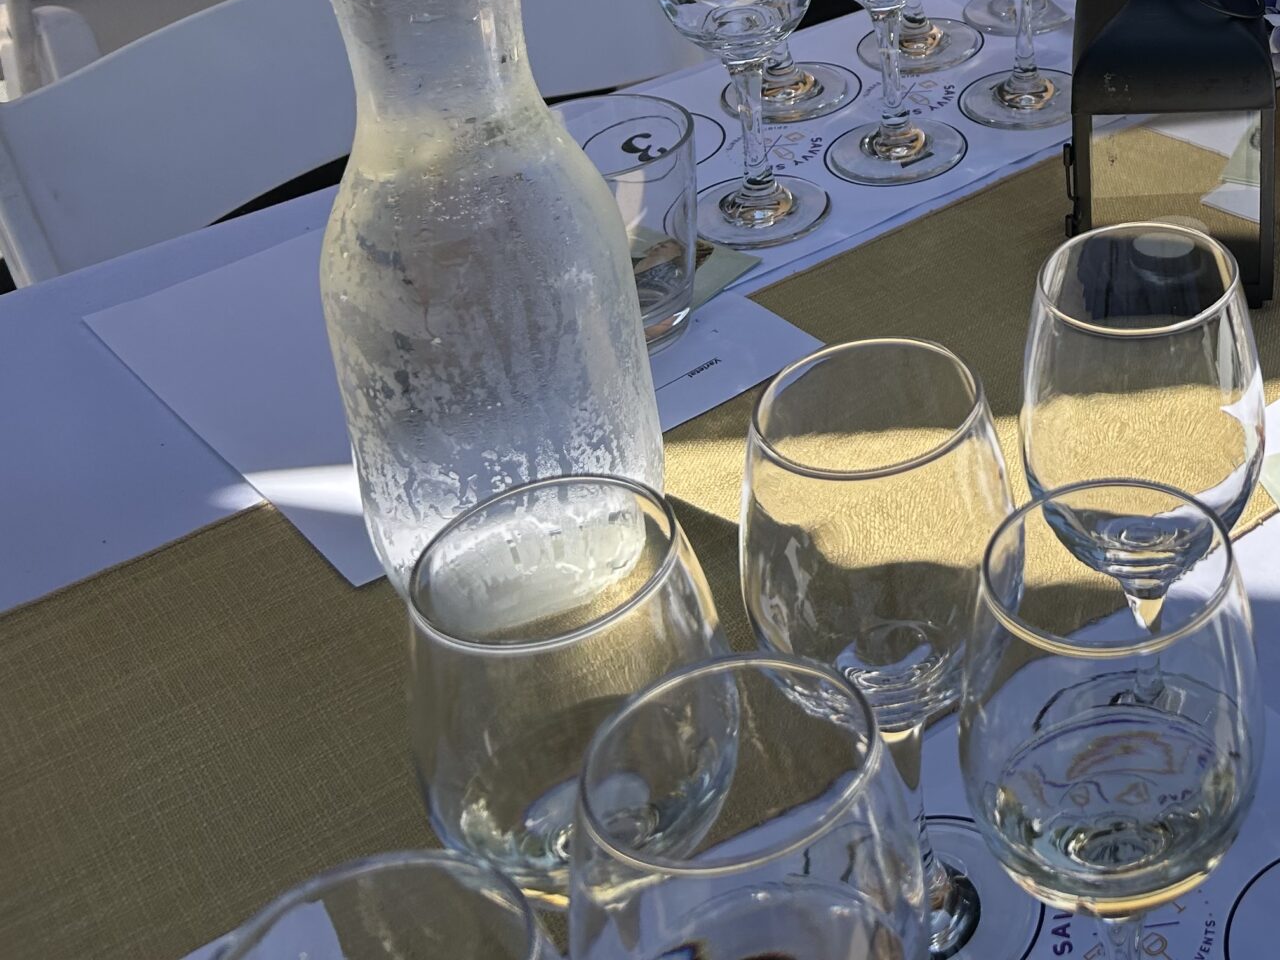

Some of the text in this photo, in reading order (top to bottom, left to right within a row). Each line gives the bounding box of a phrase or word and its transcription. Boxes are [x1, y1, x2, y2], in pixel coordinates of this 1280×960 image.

[928, 84, 956, 111] SAVVY
[621, 133, 668, 162] 3
[793, 137, 822, 166] SAVVY
[1194, 919, 1216, 960] VENTS
